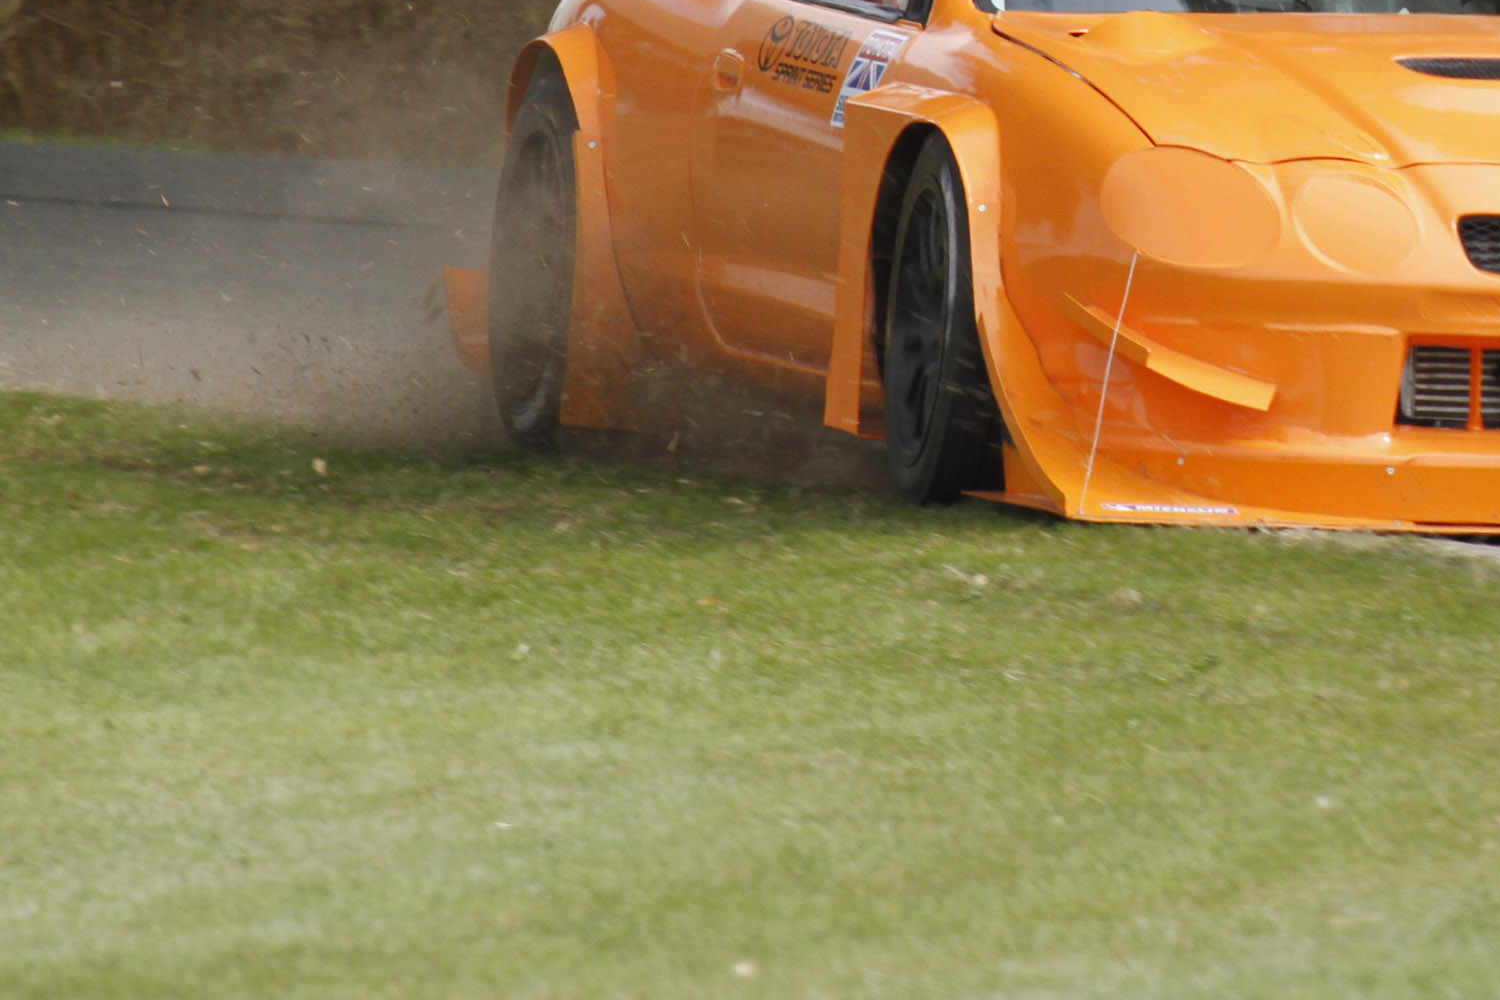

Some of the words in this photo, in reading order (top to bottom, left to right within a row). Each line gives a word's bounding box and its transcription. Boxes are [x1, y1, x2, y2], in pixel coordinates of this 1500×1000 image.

[785, 20, 851, 69] TOYOTA
[772, 62, 806, 86] SPRINT
[802, 69, 837, 94] SERIES
